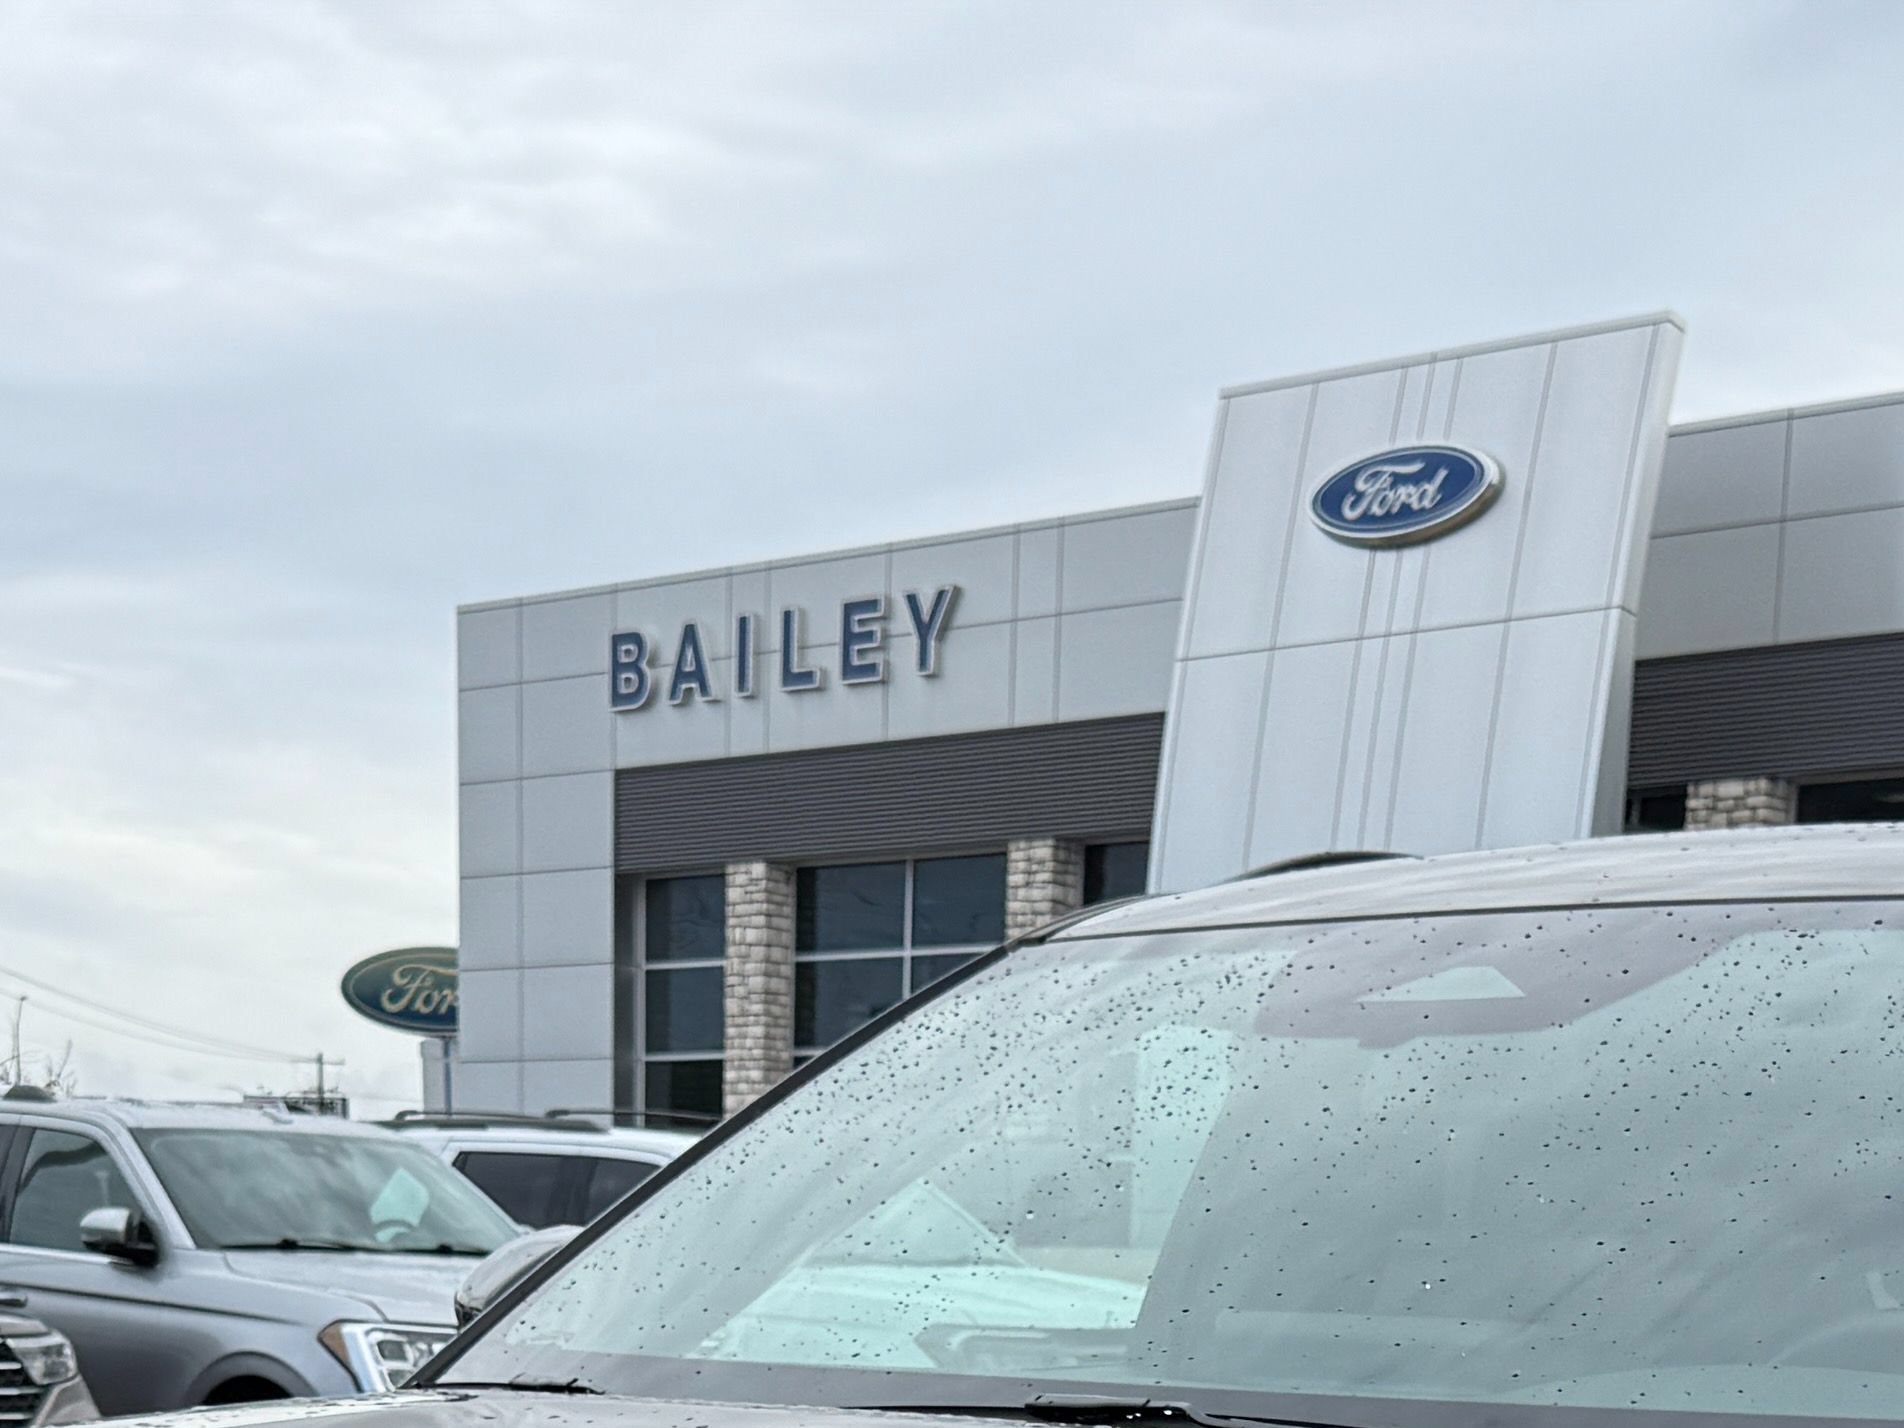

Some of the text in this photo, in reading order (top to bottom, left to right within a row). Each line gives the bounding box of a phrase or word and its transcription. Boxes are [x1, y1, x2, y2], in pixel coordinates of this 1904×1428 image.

[1341, 460, 1448, 521] Ford
[609, 584, 960, 712] BAILEY
[381, 963, 459, 1015] For
